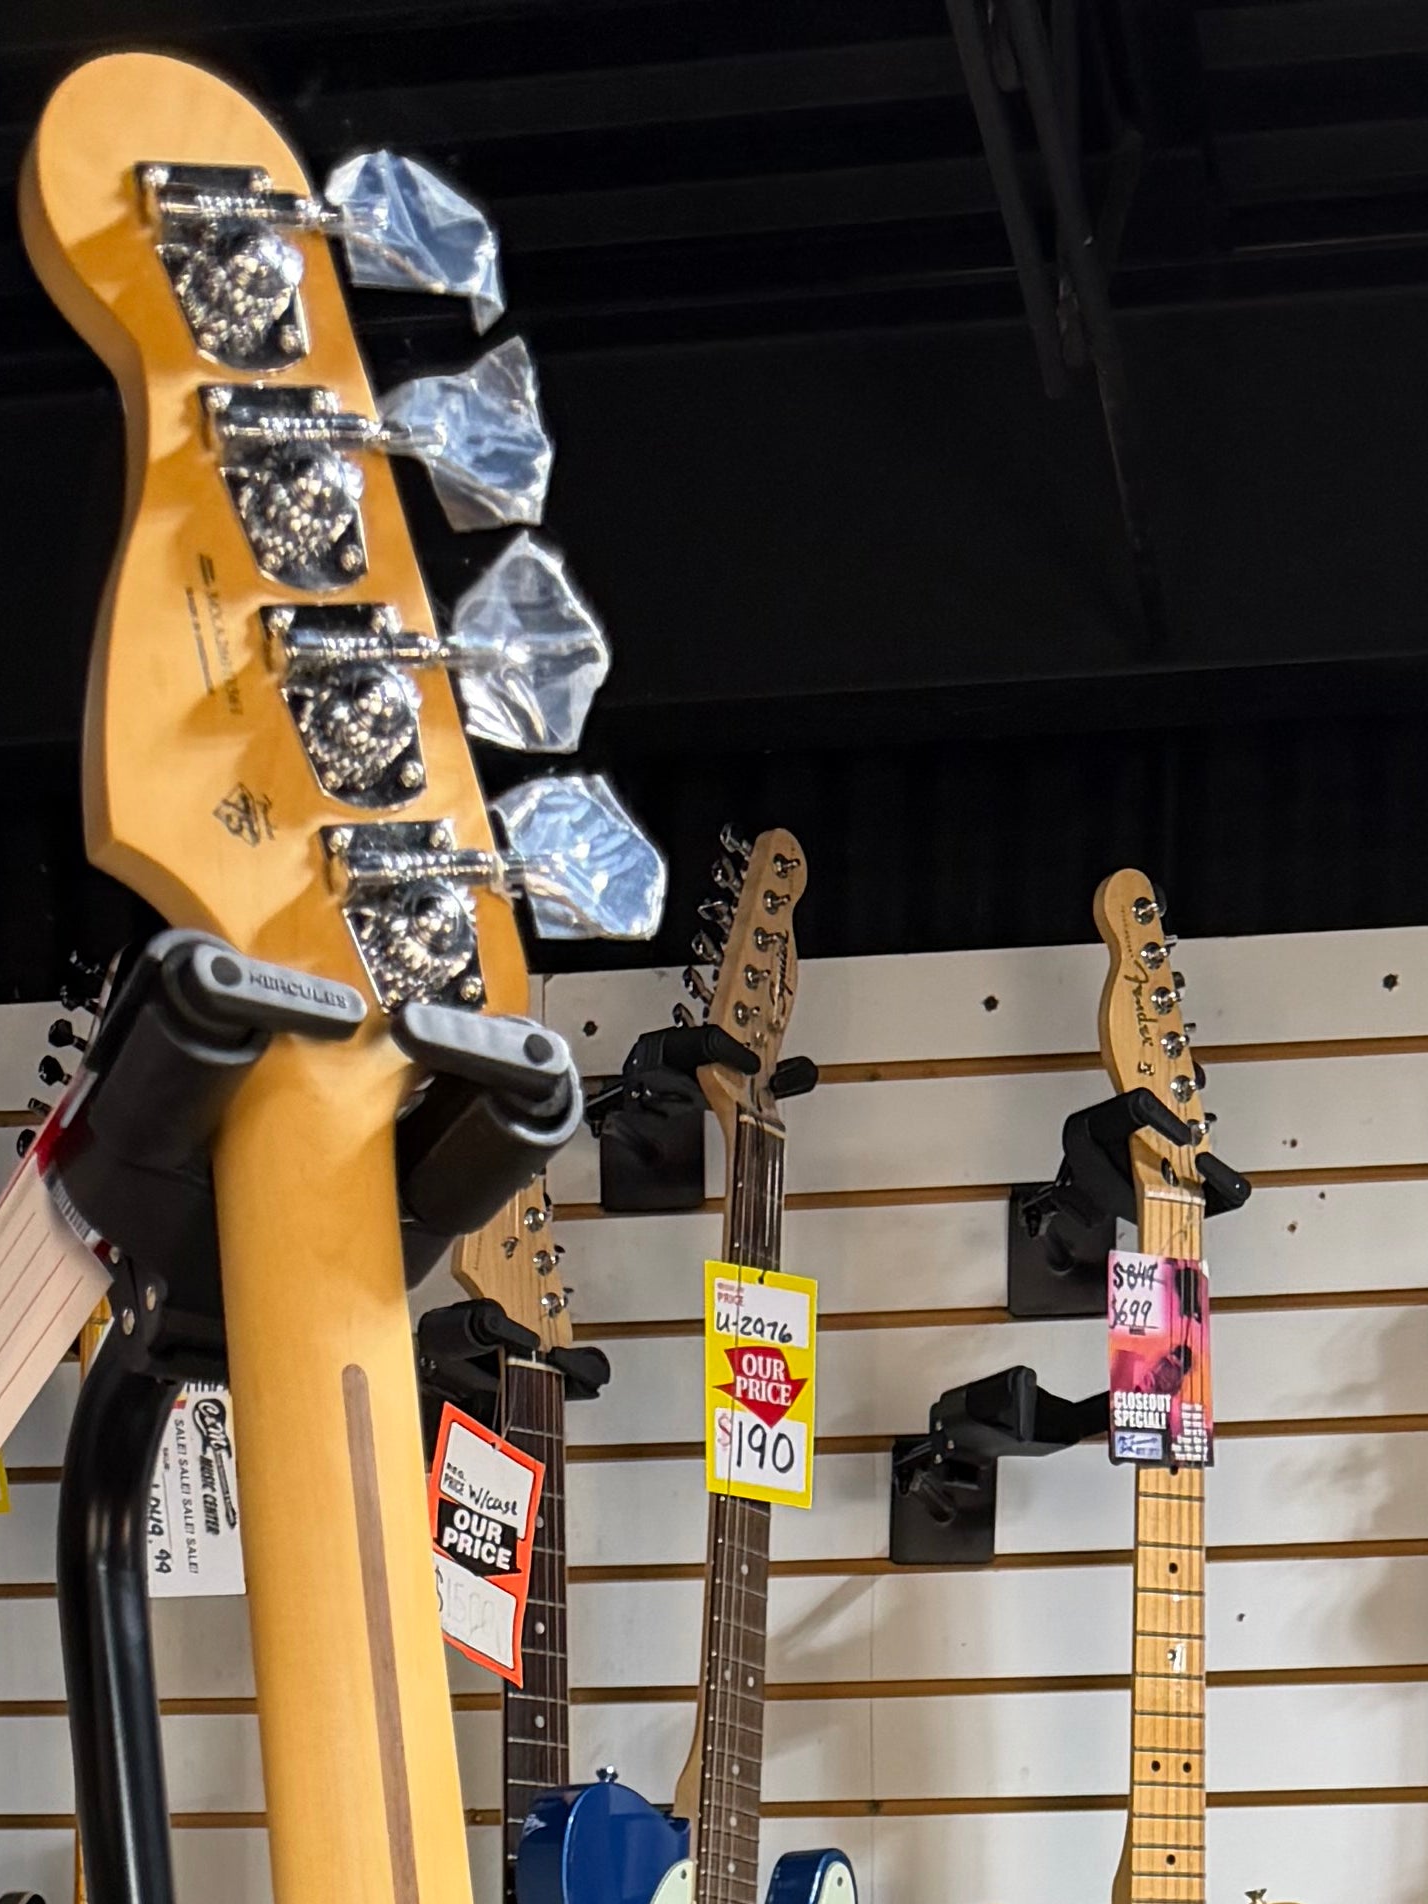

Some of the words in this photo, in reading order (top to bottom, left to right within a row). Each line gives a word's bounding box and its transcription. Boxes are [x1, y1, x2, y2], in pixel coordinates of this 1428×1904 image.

[248, 971, 348, 1009] HERCULES
[1123, 959, 1160, 1048] Fender
[740, 1353, 787, 1383] OUR
[735, 1376, 793, 1408] PRICE
[1113, 1391, 1172, 1415] CLOSEOUT
[173, 1418, 187, 1457] SALE!
[1113, 1410, 1168, 1431] SPECIAL!
[177, 1456, 192, 1495] SALE!
[199, 1453, 217, 1493] MUSIC
[181, 1495, 196, 1535] SALE!
[201, 1493, 221, 1536] CENTER
[452, 1508, 503, 1545] OUR
[185, 1536, 200, 1575] SALE!
[441, 1525, 514, 1571] PRICE
